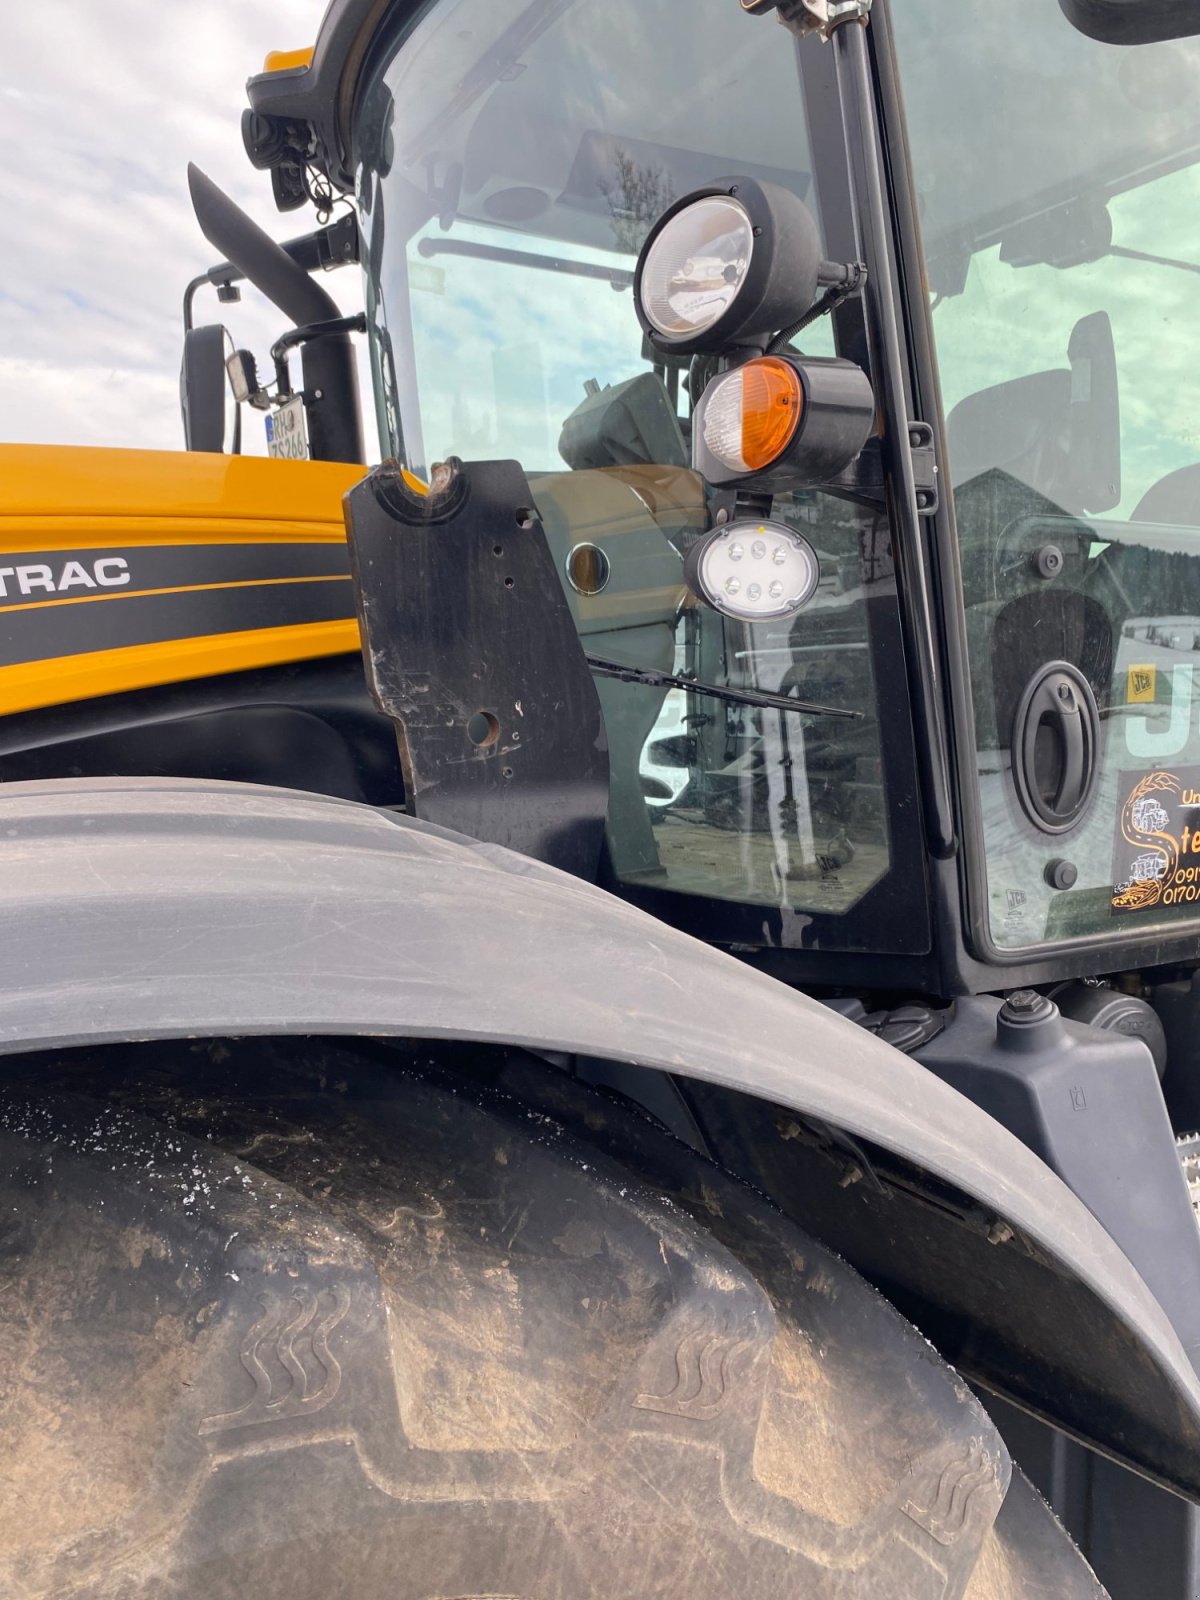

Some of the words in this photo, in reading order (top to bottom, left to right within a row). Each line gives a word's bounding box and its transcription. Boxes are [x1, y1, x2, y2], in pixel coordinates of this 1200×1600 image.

[0, 557, 131, 597] TRAC
[1133, 672, 1152, 694] JCB
[1175, 866, 1200, 884] 091
